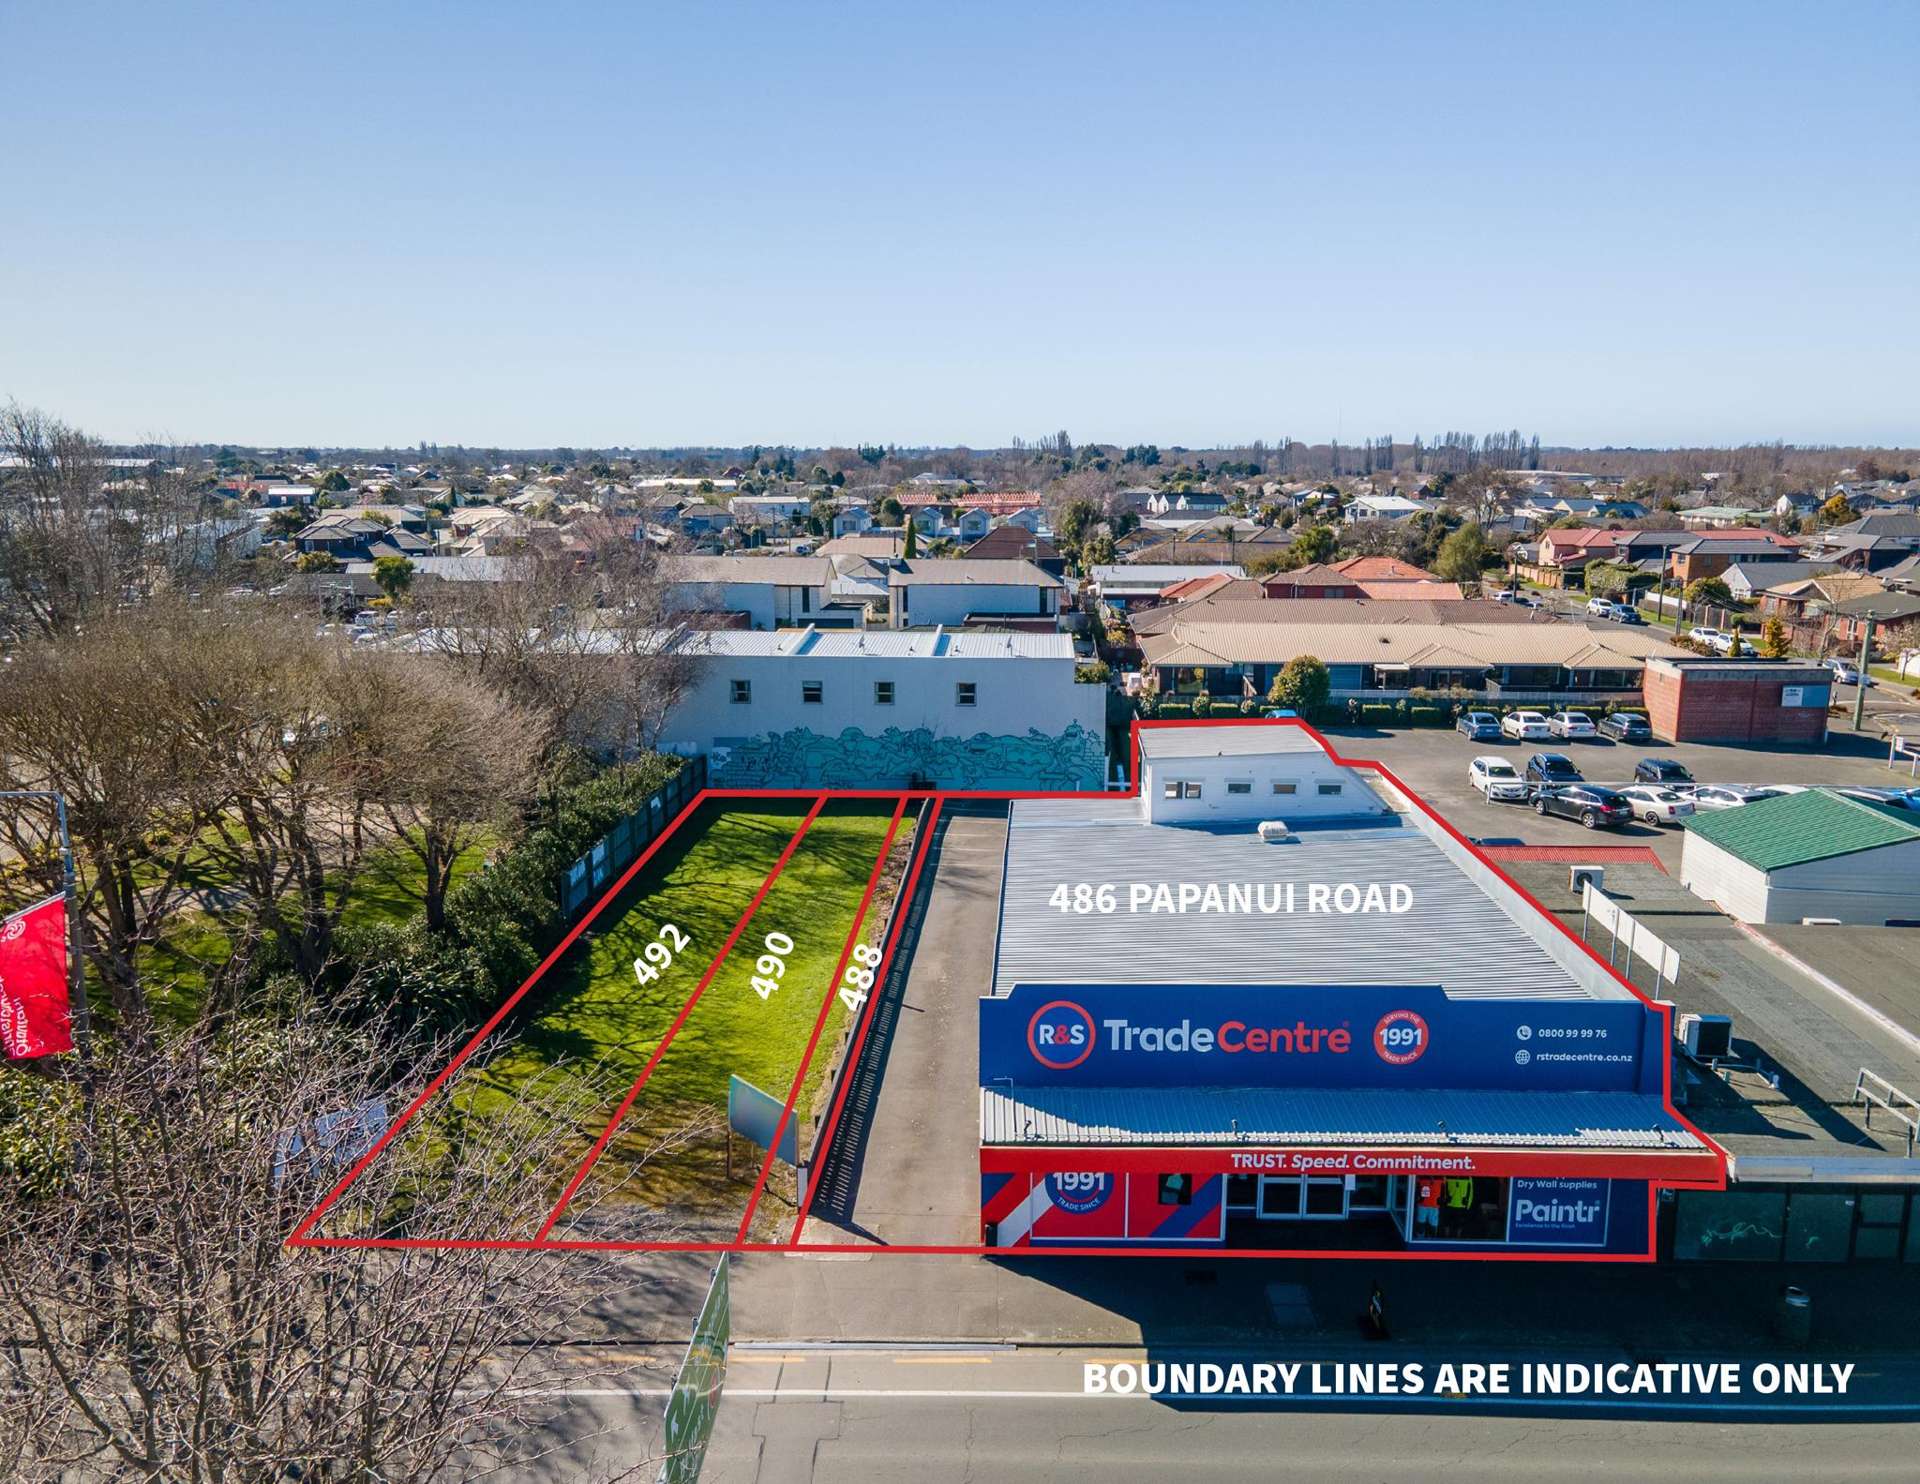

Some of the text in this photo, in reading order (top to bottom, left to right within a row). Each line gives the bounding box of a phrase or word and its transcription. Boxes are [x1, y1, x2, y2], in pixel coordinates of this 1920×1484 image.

[1039, 1019, 1351, 1054] R&S TradeCentre
[1379, 1028, 1422, 1046] 1991
[1538, 1028, 1607, 1038] 0800 99 99 76
[1536, 1053, 1633, 1062] rstradecentre.co.nz
[1231, 1153, 1476, 1171] TRUST. Speed. Commitment.
[1052, 1171, 1105, 1191] 1991
[1517, 1180, 1597, 1190] Dry Wall supplies
[1056, 1196, 1101, 1211] TRADE SINCE
[1515, 1198, 1601, 1223] Paintr
